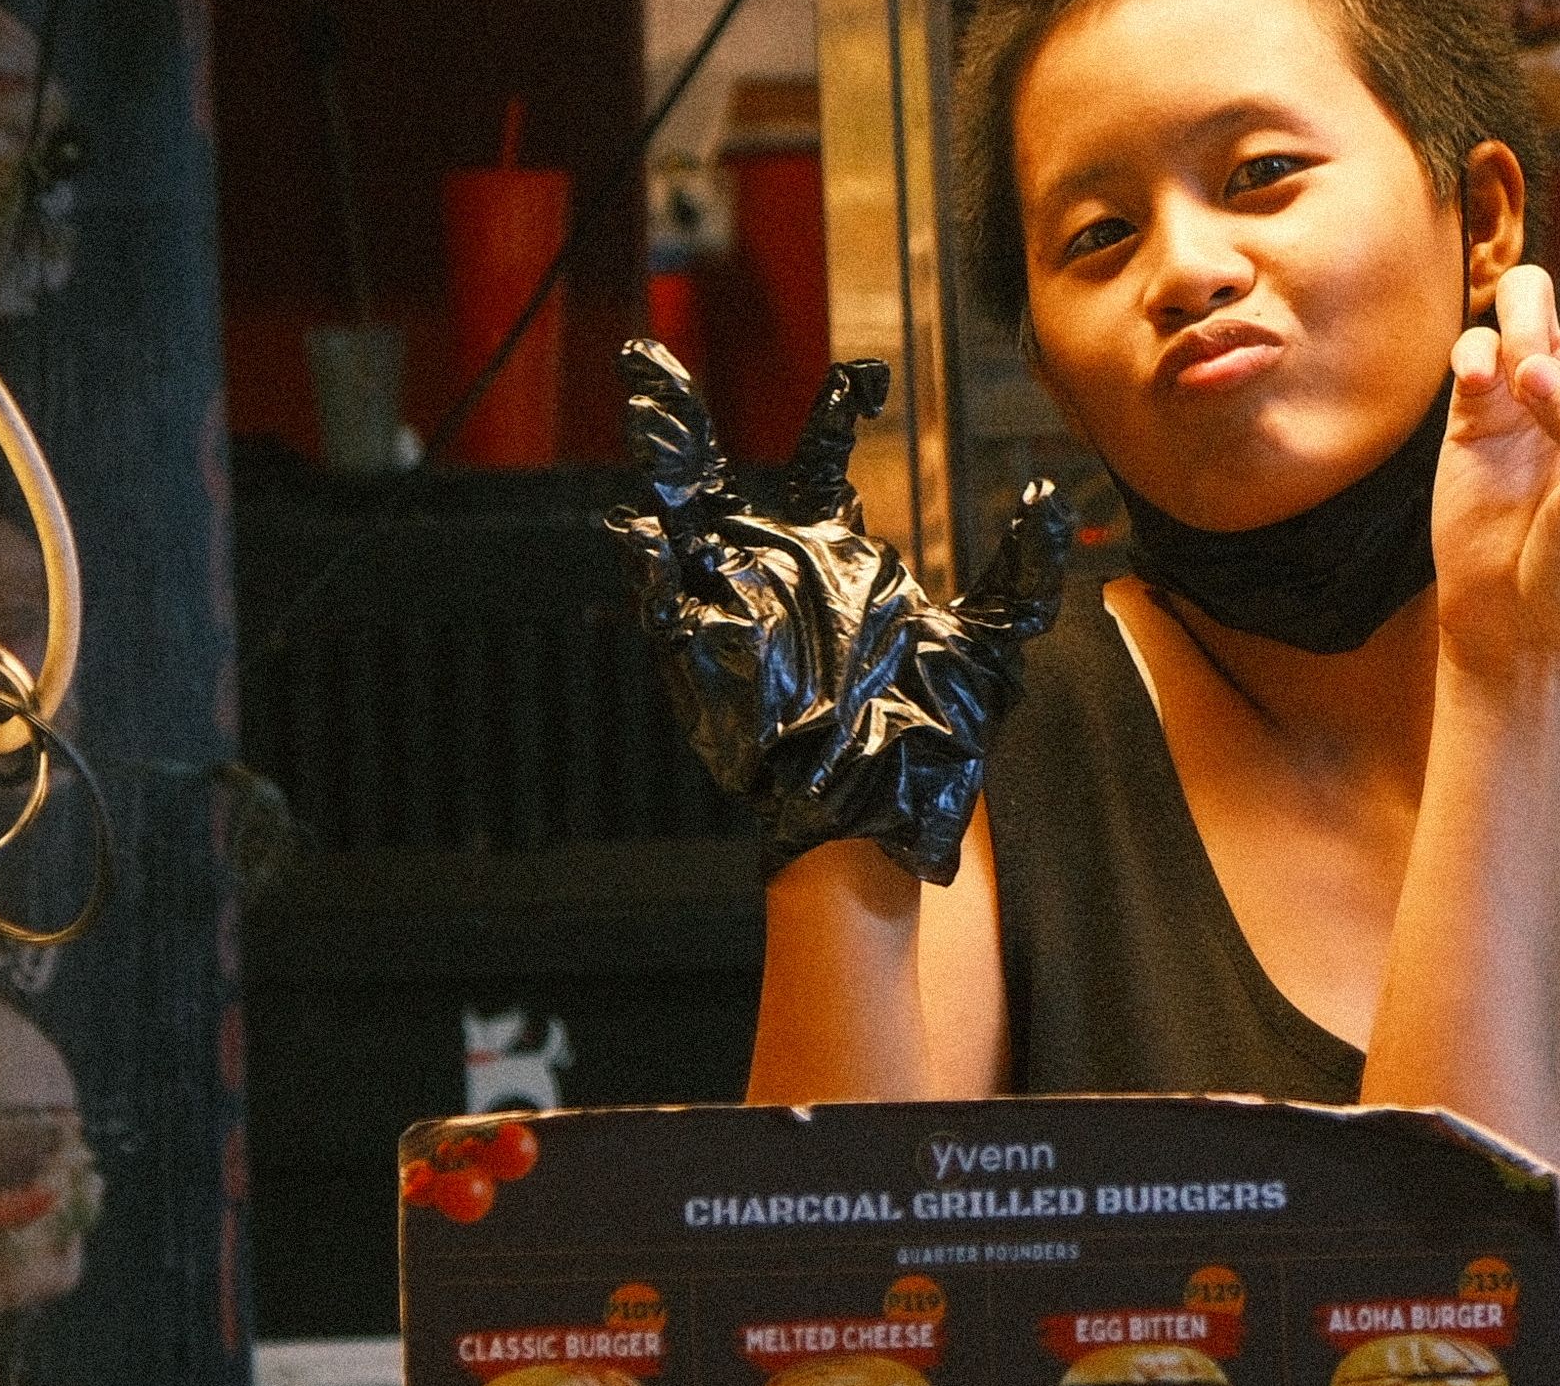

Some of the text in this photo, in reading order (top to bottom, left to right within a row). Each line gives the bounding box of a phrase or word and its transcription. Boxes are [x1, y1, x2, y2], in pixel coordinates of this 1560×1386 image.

[931, 1140, 1057, 1180] yvenn
[684, 1179, 1288, 1227] CHARCOAL GRILLED BURGERS
[985, 1241, 1080, 1263] POUNDERS
[1074, 1313, 1209, 1344] EGG BITTEN
[1328, 1302, 1505, 1334] ALOHA BURGER
[458, 1331, 661, 1363] CLASSIC BURGER
[745, 1321, 934, 1354] MELTED CHEESE
